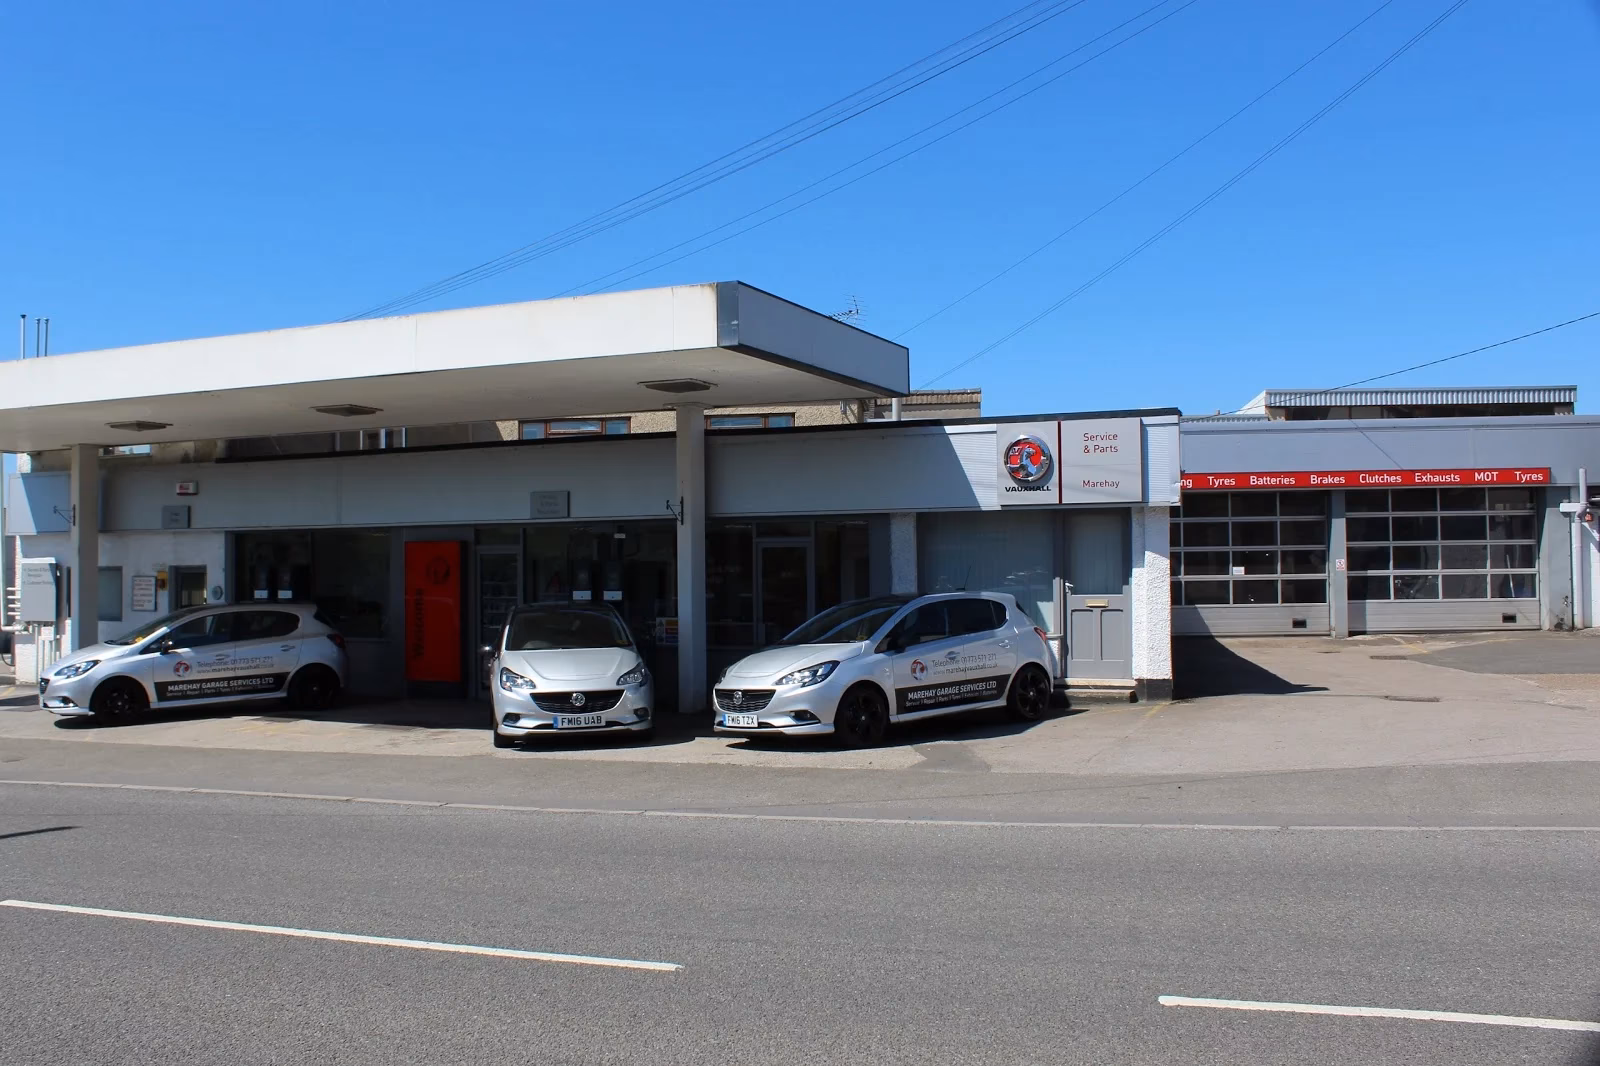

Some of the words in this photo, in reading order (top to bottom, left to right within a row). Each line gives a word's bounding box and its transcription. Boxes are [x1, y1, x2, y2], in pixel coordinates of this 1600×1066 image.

[1083, 432, 1118, 442] Service
[1083, 445, 1090, 453] &
[1093, 444, 1118, 453] Parts
[1207, 476, 1235, 487] Tyres
[1250, 475, 1295, 485] Batteries
[1310, 474, 1345, 484] Brakes
[1359, 473, 1402, 483] Clutches
[1415, 472, 1460, 482] Exhausts
[1474, 471, 1498, 481] MOT
[1514, 471, 1543, 482] Tyres
[1082, 480, 1120, 489] Marehay
[961, 655, 977, 664] 01773
[168, 683, 201, 691] MAREHAY
[201, 680, 228, 689] GARAGE
[229, 678, 261, 687] SERVICES
[908, 689, 936, 700] MAREHAY
[937, 686, 959, 696] GARAGE
[960, 682, 986, 693] SERVICES
[987, 681, 997, 689] LTD
[561, 717, 581, 726] FM16
[584, 715, 602, 725] UAB
[728, 715, 740, 724] FM16
[742, 716, 755, 725] TZX
